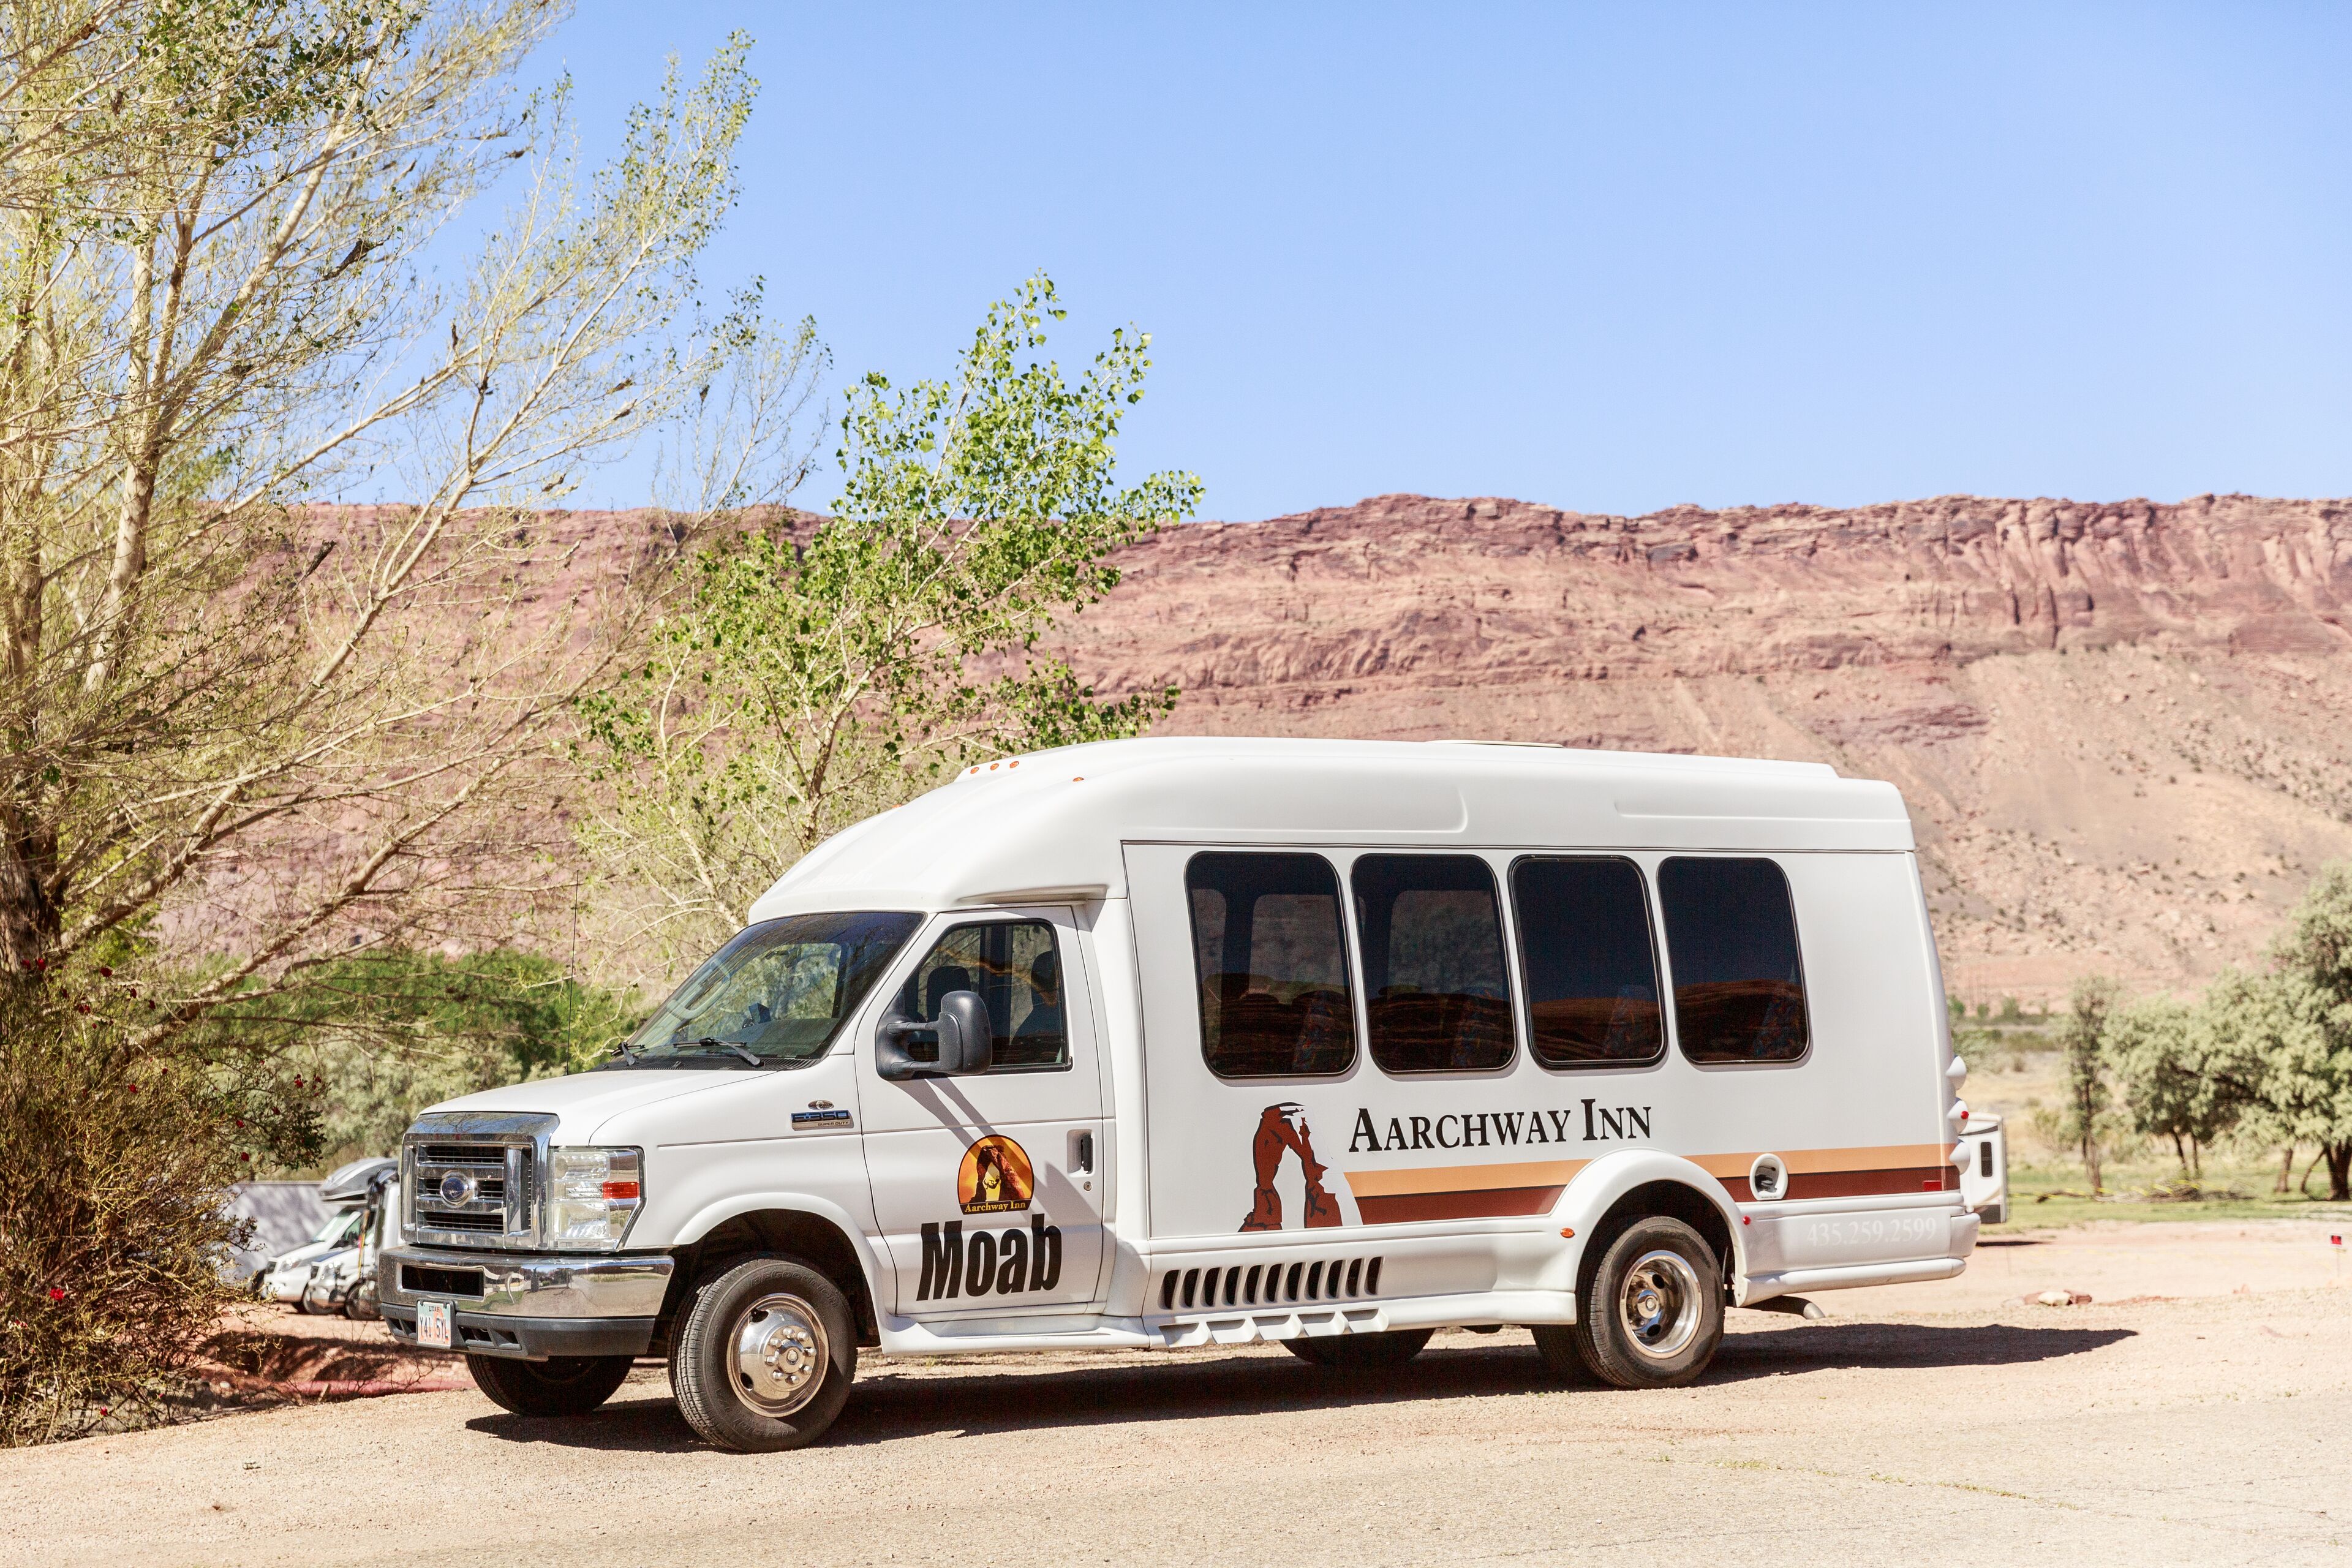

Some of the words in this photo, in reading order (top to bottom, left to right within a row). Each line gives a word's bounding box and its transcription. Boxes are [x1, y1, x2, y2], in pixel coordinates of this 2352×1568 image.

[1348, 1107, 1570, 1153] AARCHWAY
[1580, 1098, 1652, 1141] INN
[964, 1202, 1009, 1213] Aarchway
[1010, 1200, 1027, 1209] Inn
[1807, 1217, 1937, 1247] 435.259.2599
[916, 1213, 1062, 1301] Moab
[420, 1317, 432, 1338] Y41
